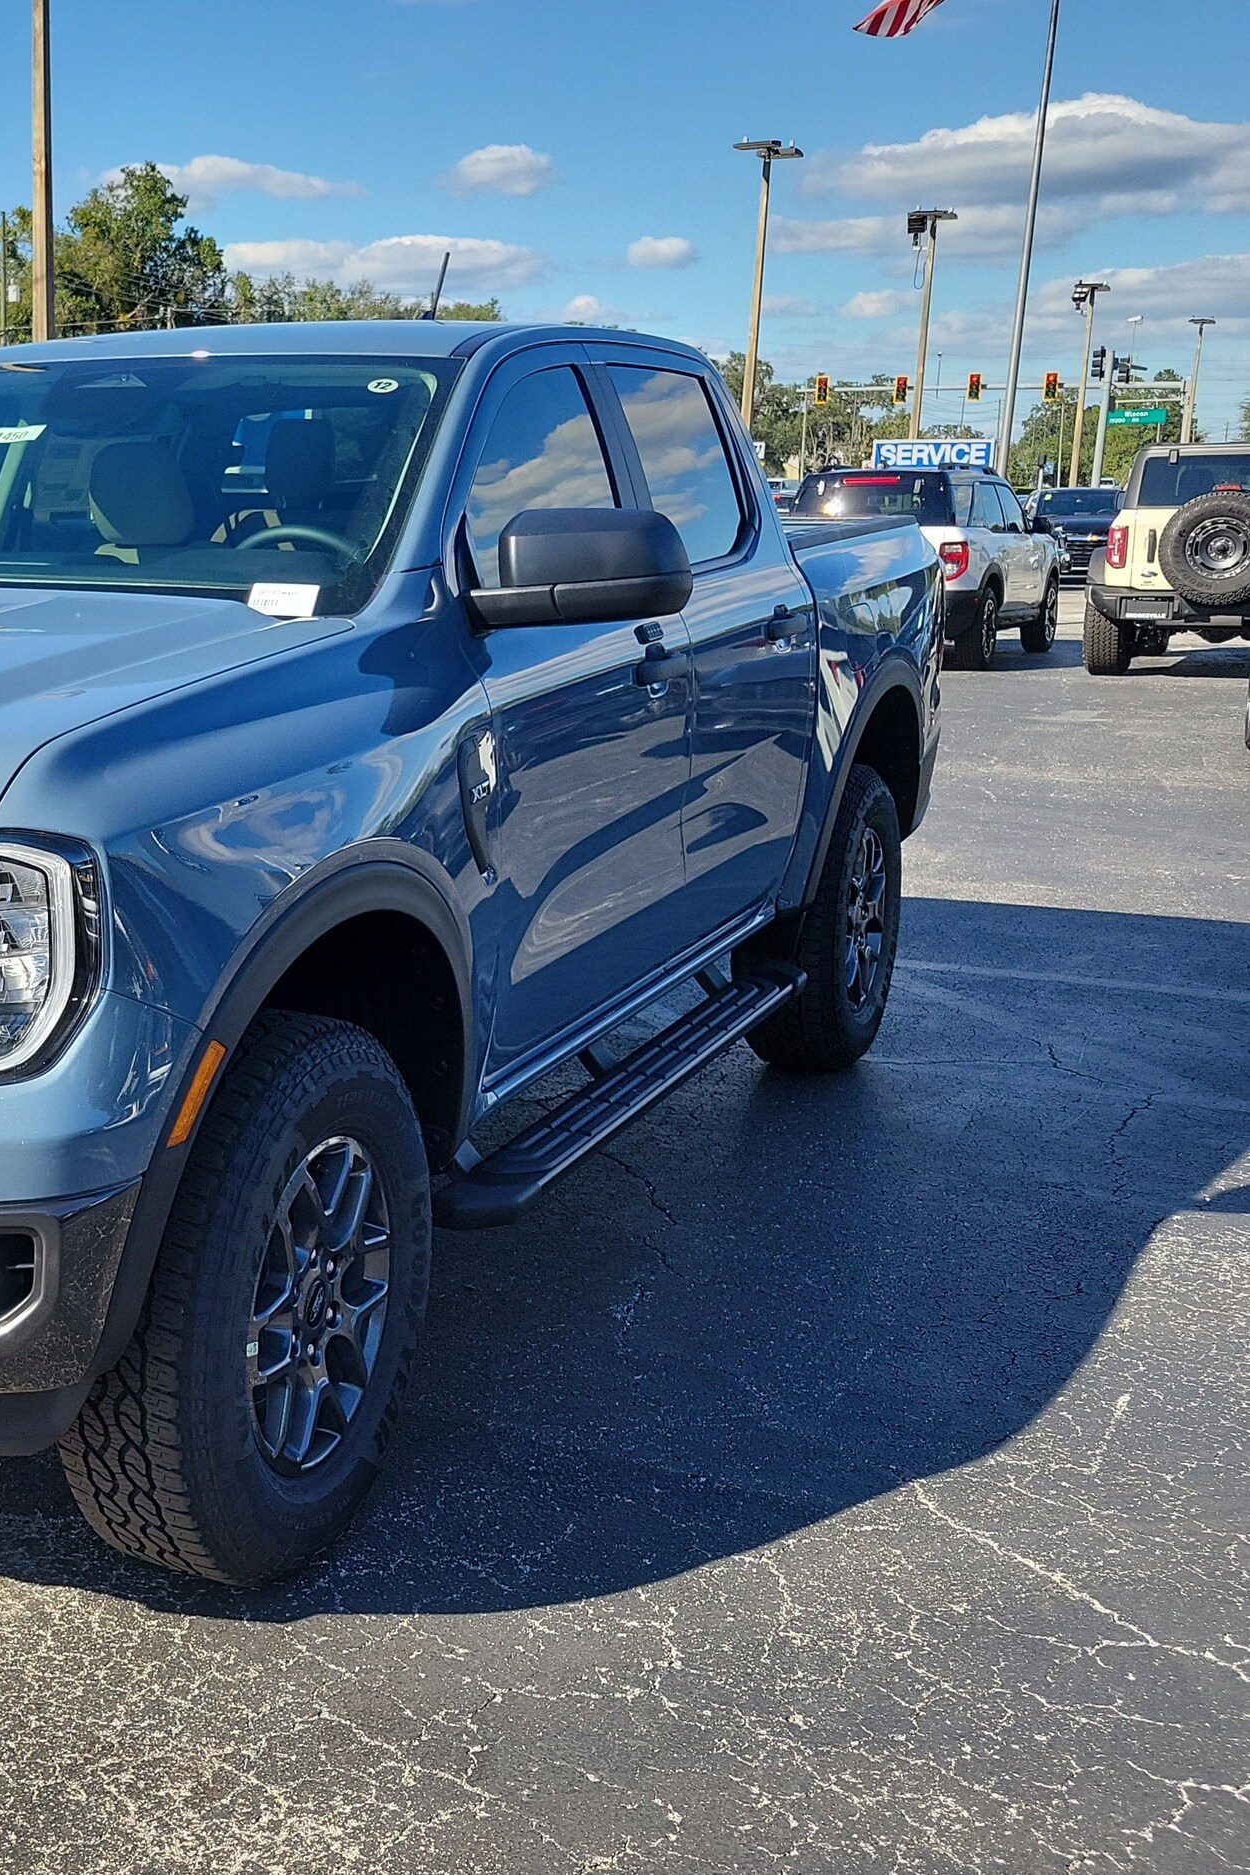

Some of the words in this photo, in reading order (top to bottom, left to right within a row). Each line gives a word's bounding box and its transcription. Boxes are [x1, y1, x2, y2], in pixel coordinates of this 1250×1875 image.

[373, 381, 393, 390] 12
[880, 444, 987, 466] SERVICE
[471, 779, 490, 804] XLT
